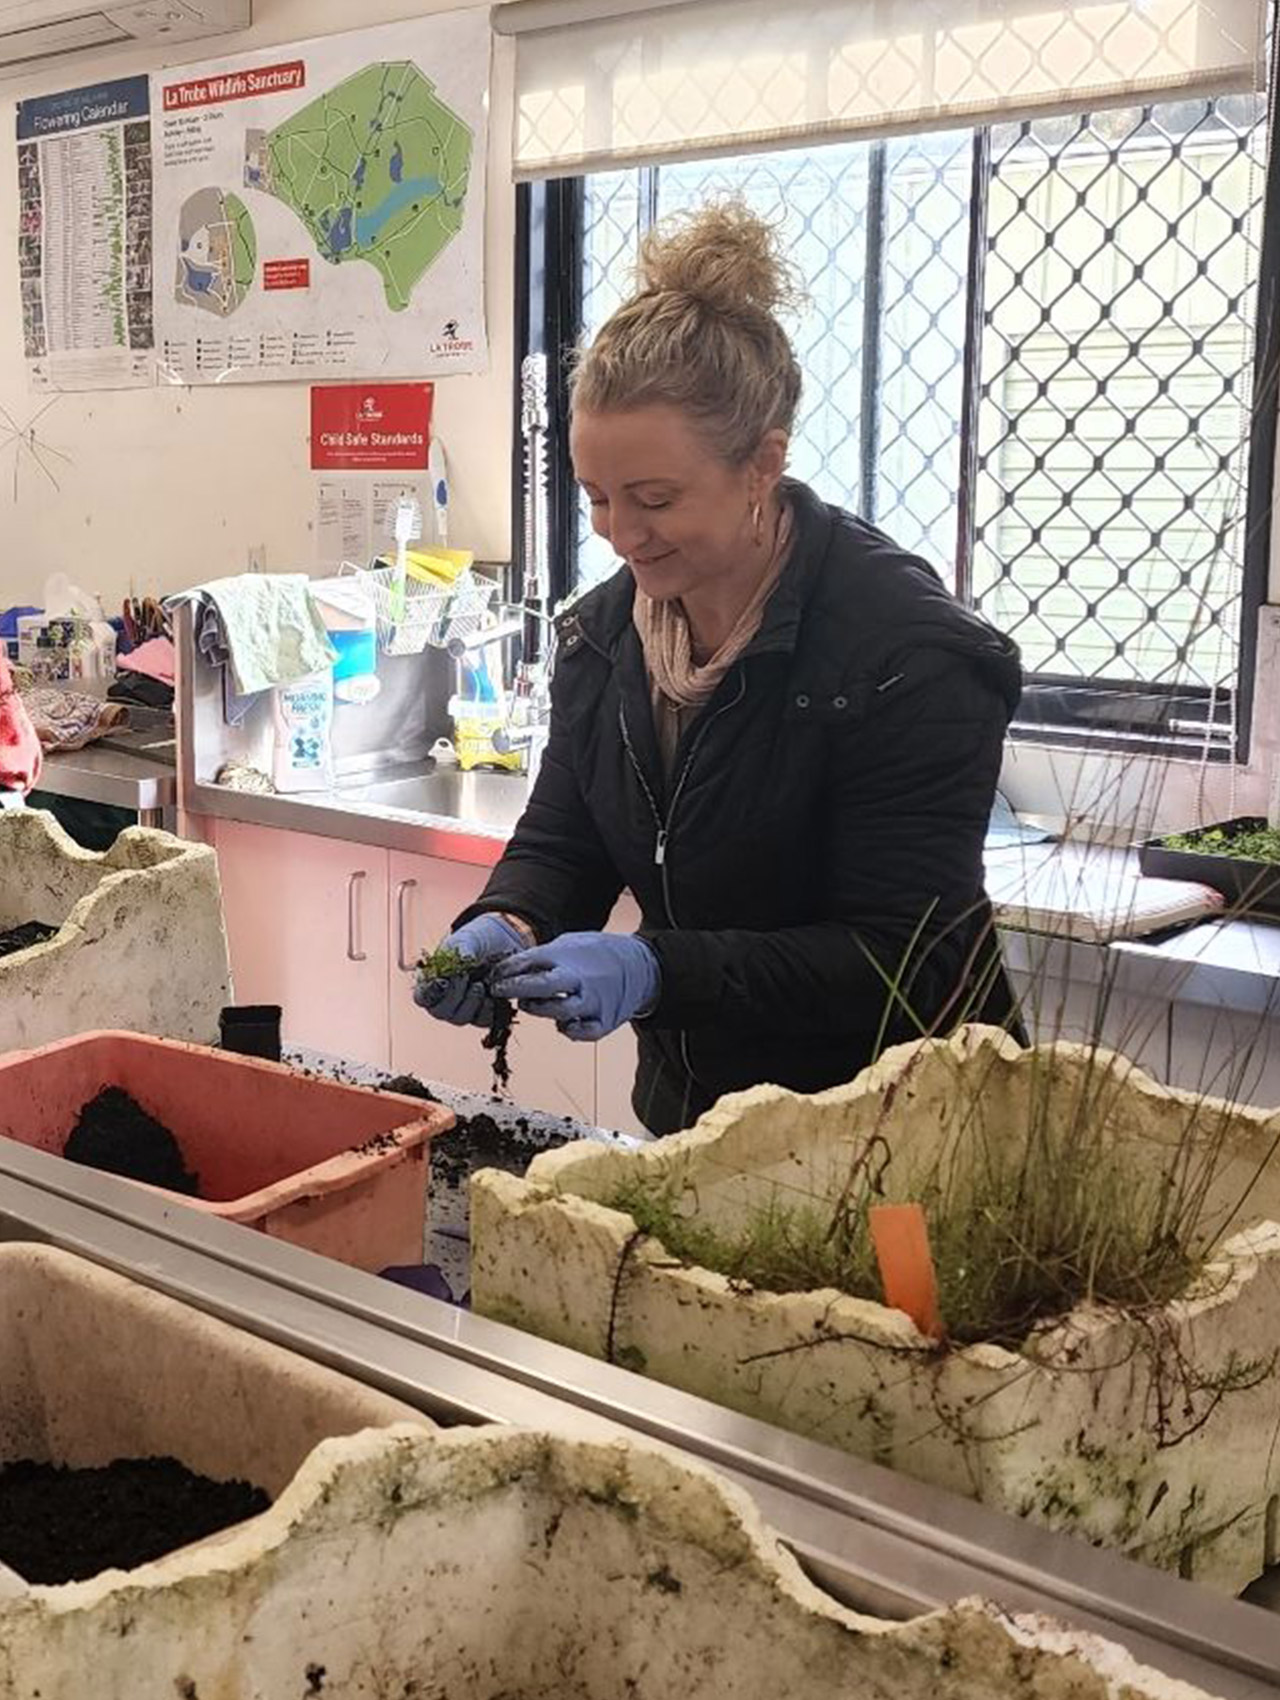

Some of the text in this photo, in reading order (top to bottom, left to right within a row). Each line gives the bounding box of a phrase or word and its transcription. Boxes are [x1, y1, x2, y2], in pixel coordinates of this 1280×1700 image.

[165, 69, 302, 106] La Trobe Wildlife Sanctuary
[33, 110, 81, 131] Flowering
[81, 100, 129, 122] Calendar
[320, 431, 424, 446] Child Safe Standards
